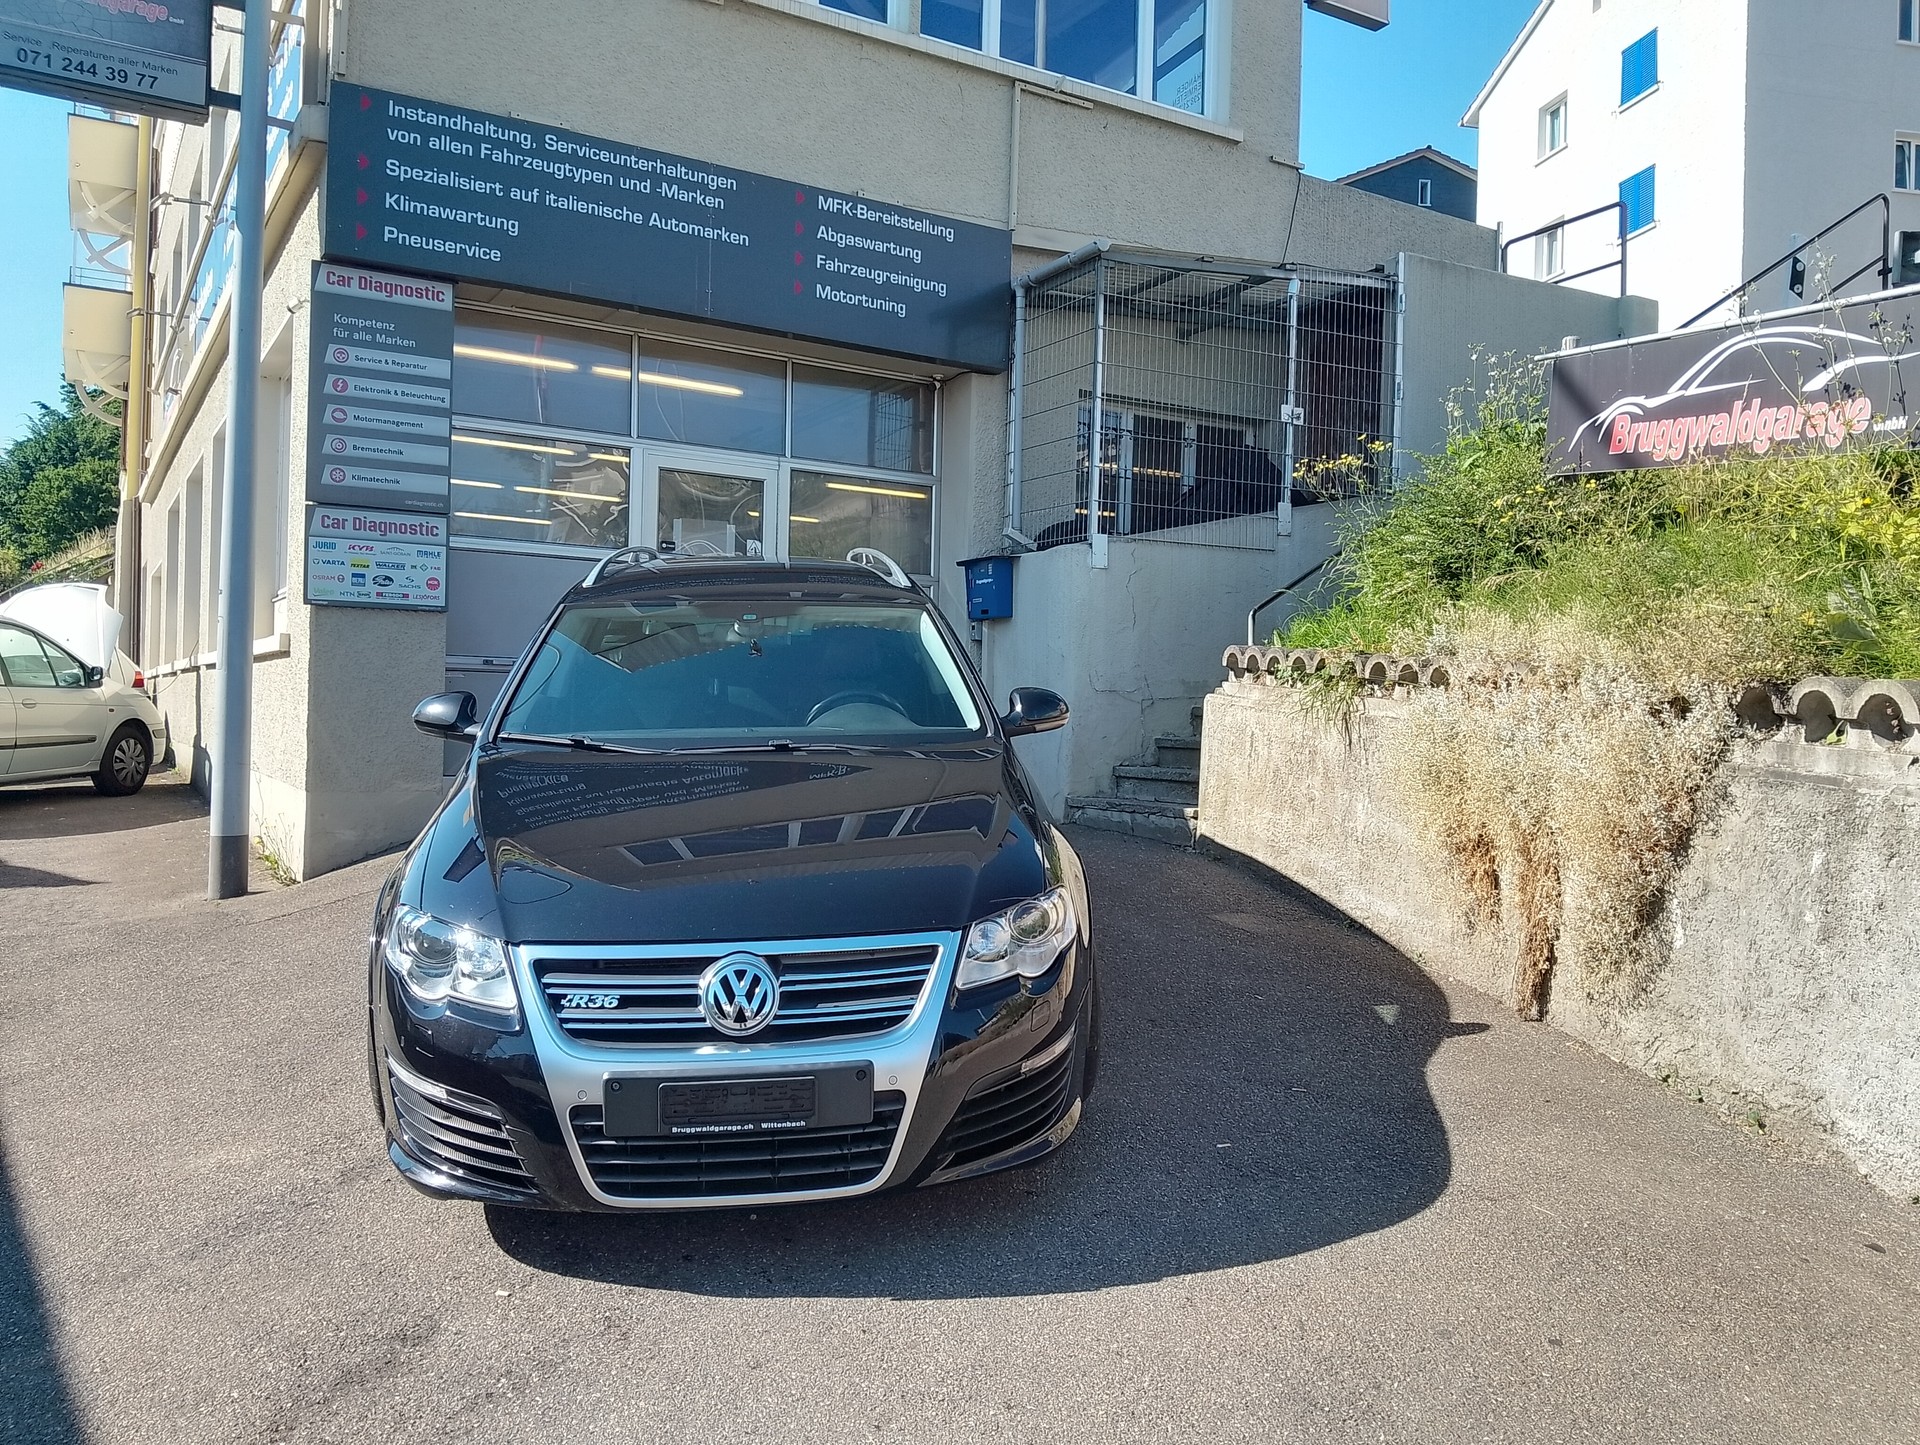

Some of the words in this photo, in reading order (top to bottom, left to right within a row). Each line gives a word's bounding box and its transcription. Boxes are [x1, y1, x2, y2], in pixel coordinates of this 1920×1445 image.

[3, 30, 42, 47] Service
[118, 56, 139, 68] aller
[142, 61, 178, 76] Marken
[17, 47, 52, 68] 071
[61, 57, 98, 77] 244
[105, 66, 128, 84] 39
[136, 72, 158, 90] 77
[388, 100, 537, 149] Instandhaltung,
[544, 134, 737, 191] Serviceunterhaltungen
[387, 128, 422, 146] von
[428, 137, 473, 156] allen
[480, 143, 613, 186] Fahrzeugtypen
[619, 174, 651, 194] und
[656, 183, 725, 210] -Marken
[385, 193, 519, 237] Klimawartung
[386, 159, 504, 197] Spezialisiert
[509, 187, 540, 204] auf
[545, 190, 643, 225] italienische
[649, 213, 750, 247] Automarken
[818, 195, 954, 242] MFK-Bereitstellung
[384, 226, 501, 262] Pneuservice
[817, 225, 922, 263] Abgaswartung
[326, 270, 354, 288] Car
[358, 275, 445, 302] Diagnostic
[816, 255, 947, 296] Fahrzeugreinigung
[816, 284, 906, 317] Motortuning
[333, 327, 349, 338] für
[353, 332, 372, 341] alle
[376, 333, 416, 347] Marken
[334, 313, 395, 331] Kompetenz
[354, 355, 382, 365] Service
[392, 359, 428, 371] Reparatur
[354, 384, 392, 396] Elektronik
[401, 390, 446, 403] Beleuchtung
[353, 414, 424, 429] Motormanagement
[352, 444, 404, 456] Bremstechnik
[352, 474, 401, 485] Klimatechnik
[321, 514, 348, 530] Car
[353, 517, 440, 537] Diagnostic
[313, 541, 336, 550] JURID
[570, 994, 620, 1008] R36
[672, 1123, 754, 1133] Bruggwaldgarage.ch
[761, 1120, 806, 1129] Wittenbach
